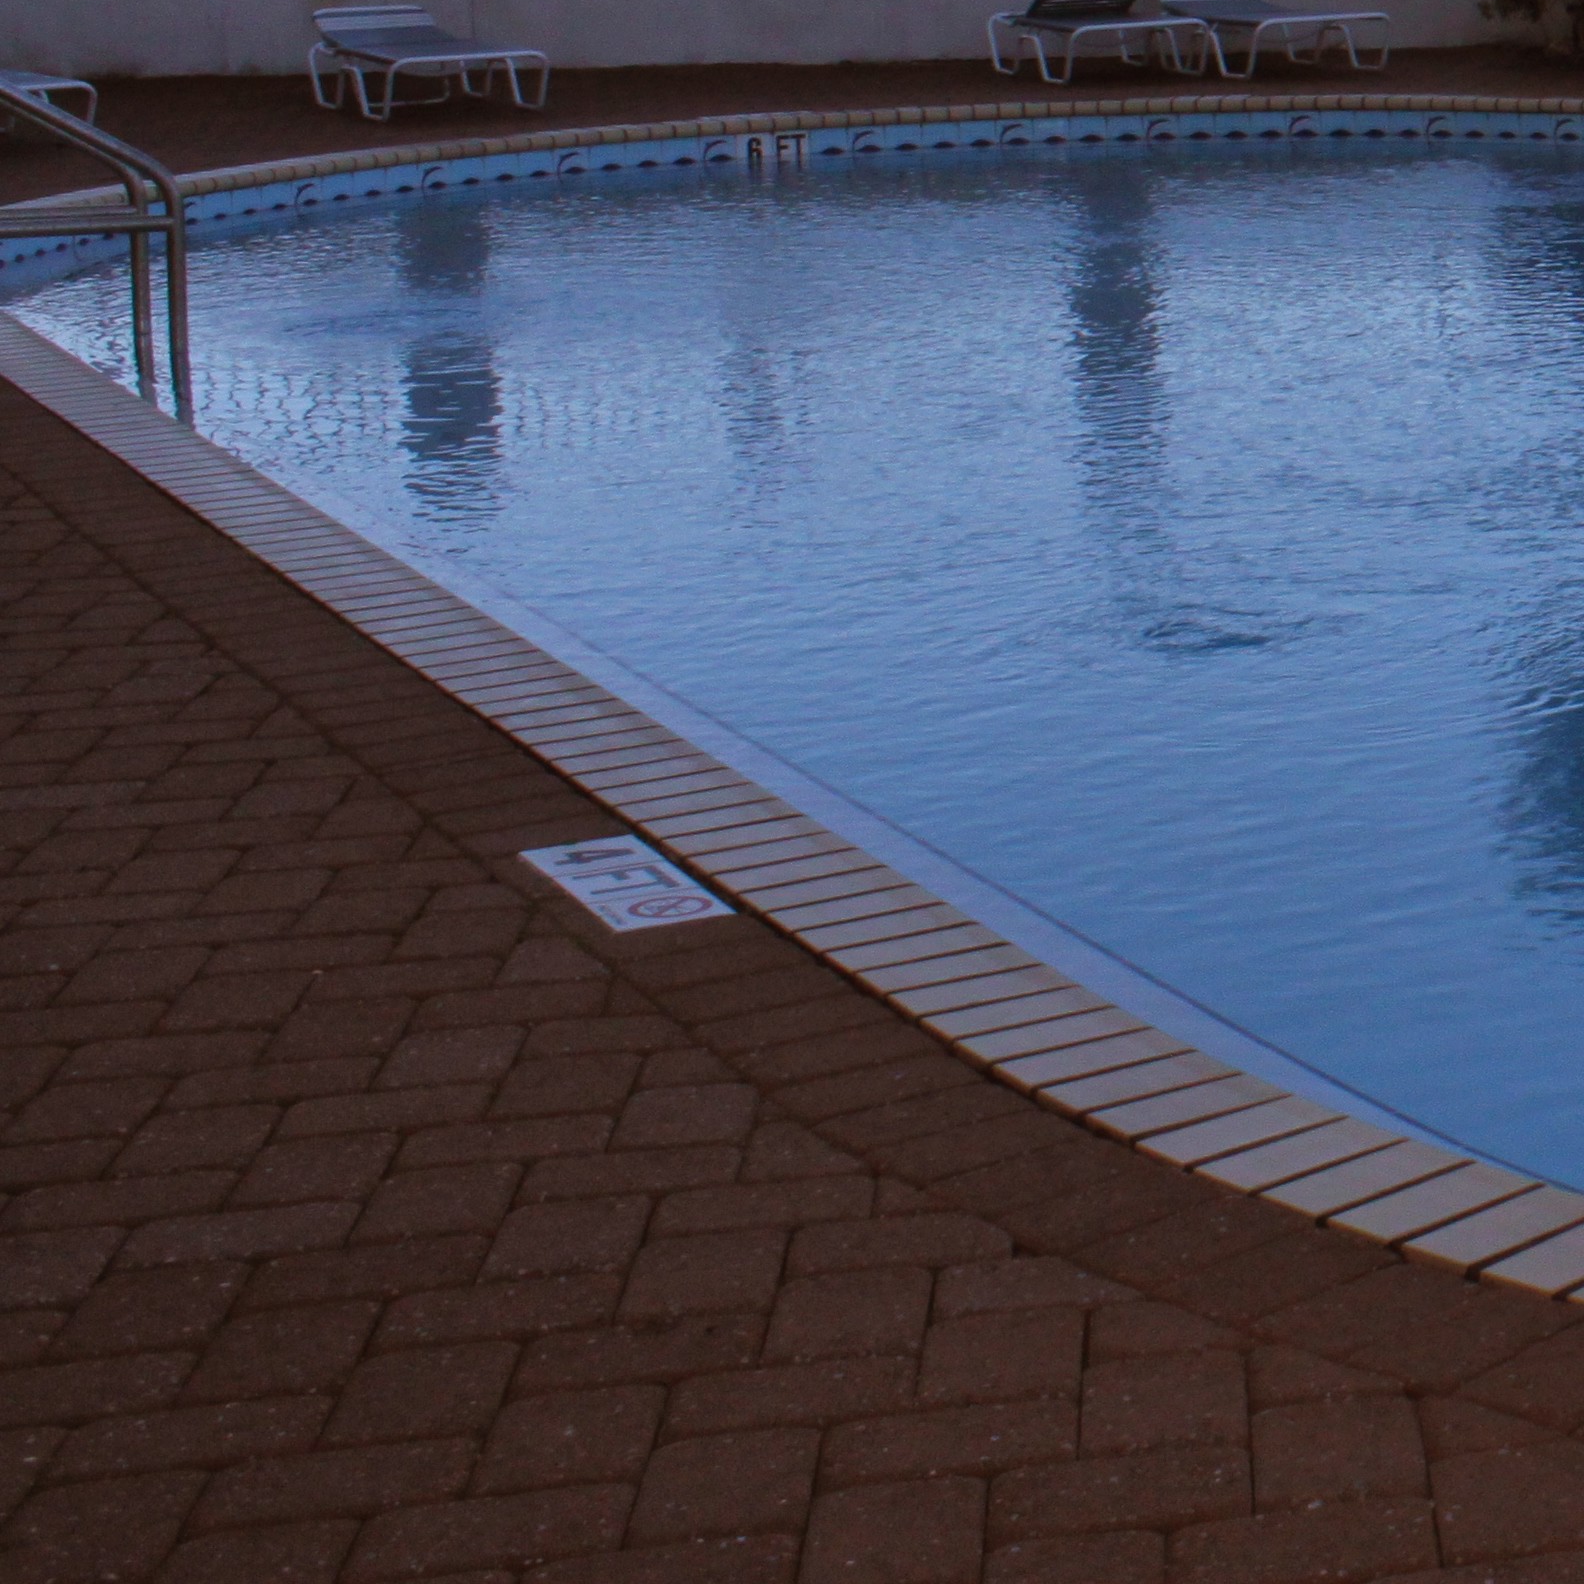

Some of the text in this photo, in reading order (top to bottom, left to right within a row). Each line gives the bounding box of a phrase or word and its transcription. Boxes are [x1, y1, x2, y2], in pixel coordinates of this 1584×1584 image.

[776, 133, 806, 164] FT
[554, 847, 681, 895] 4 FT
